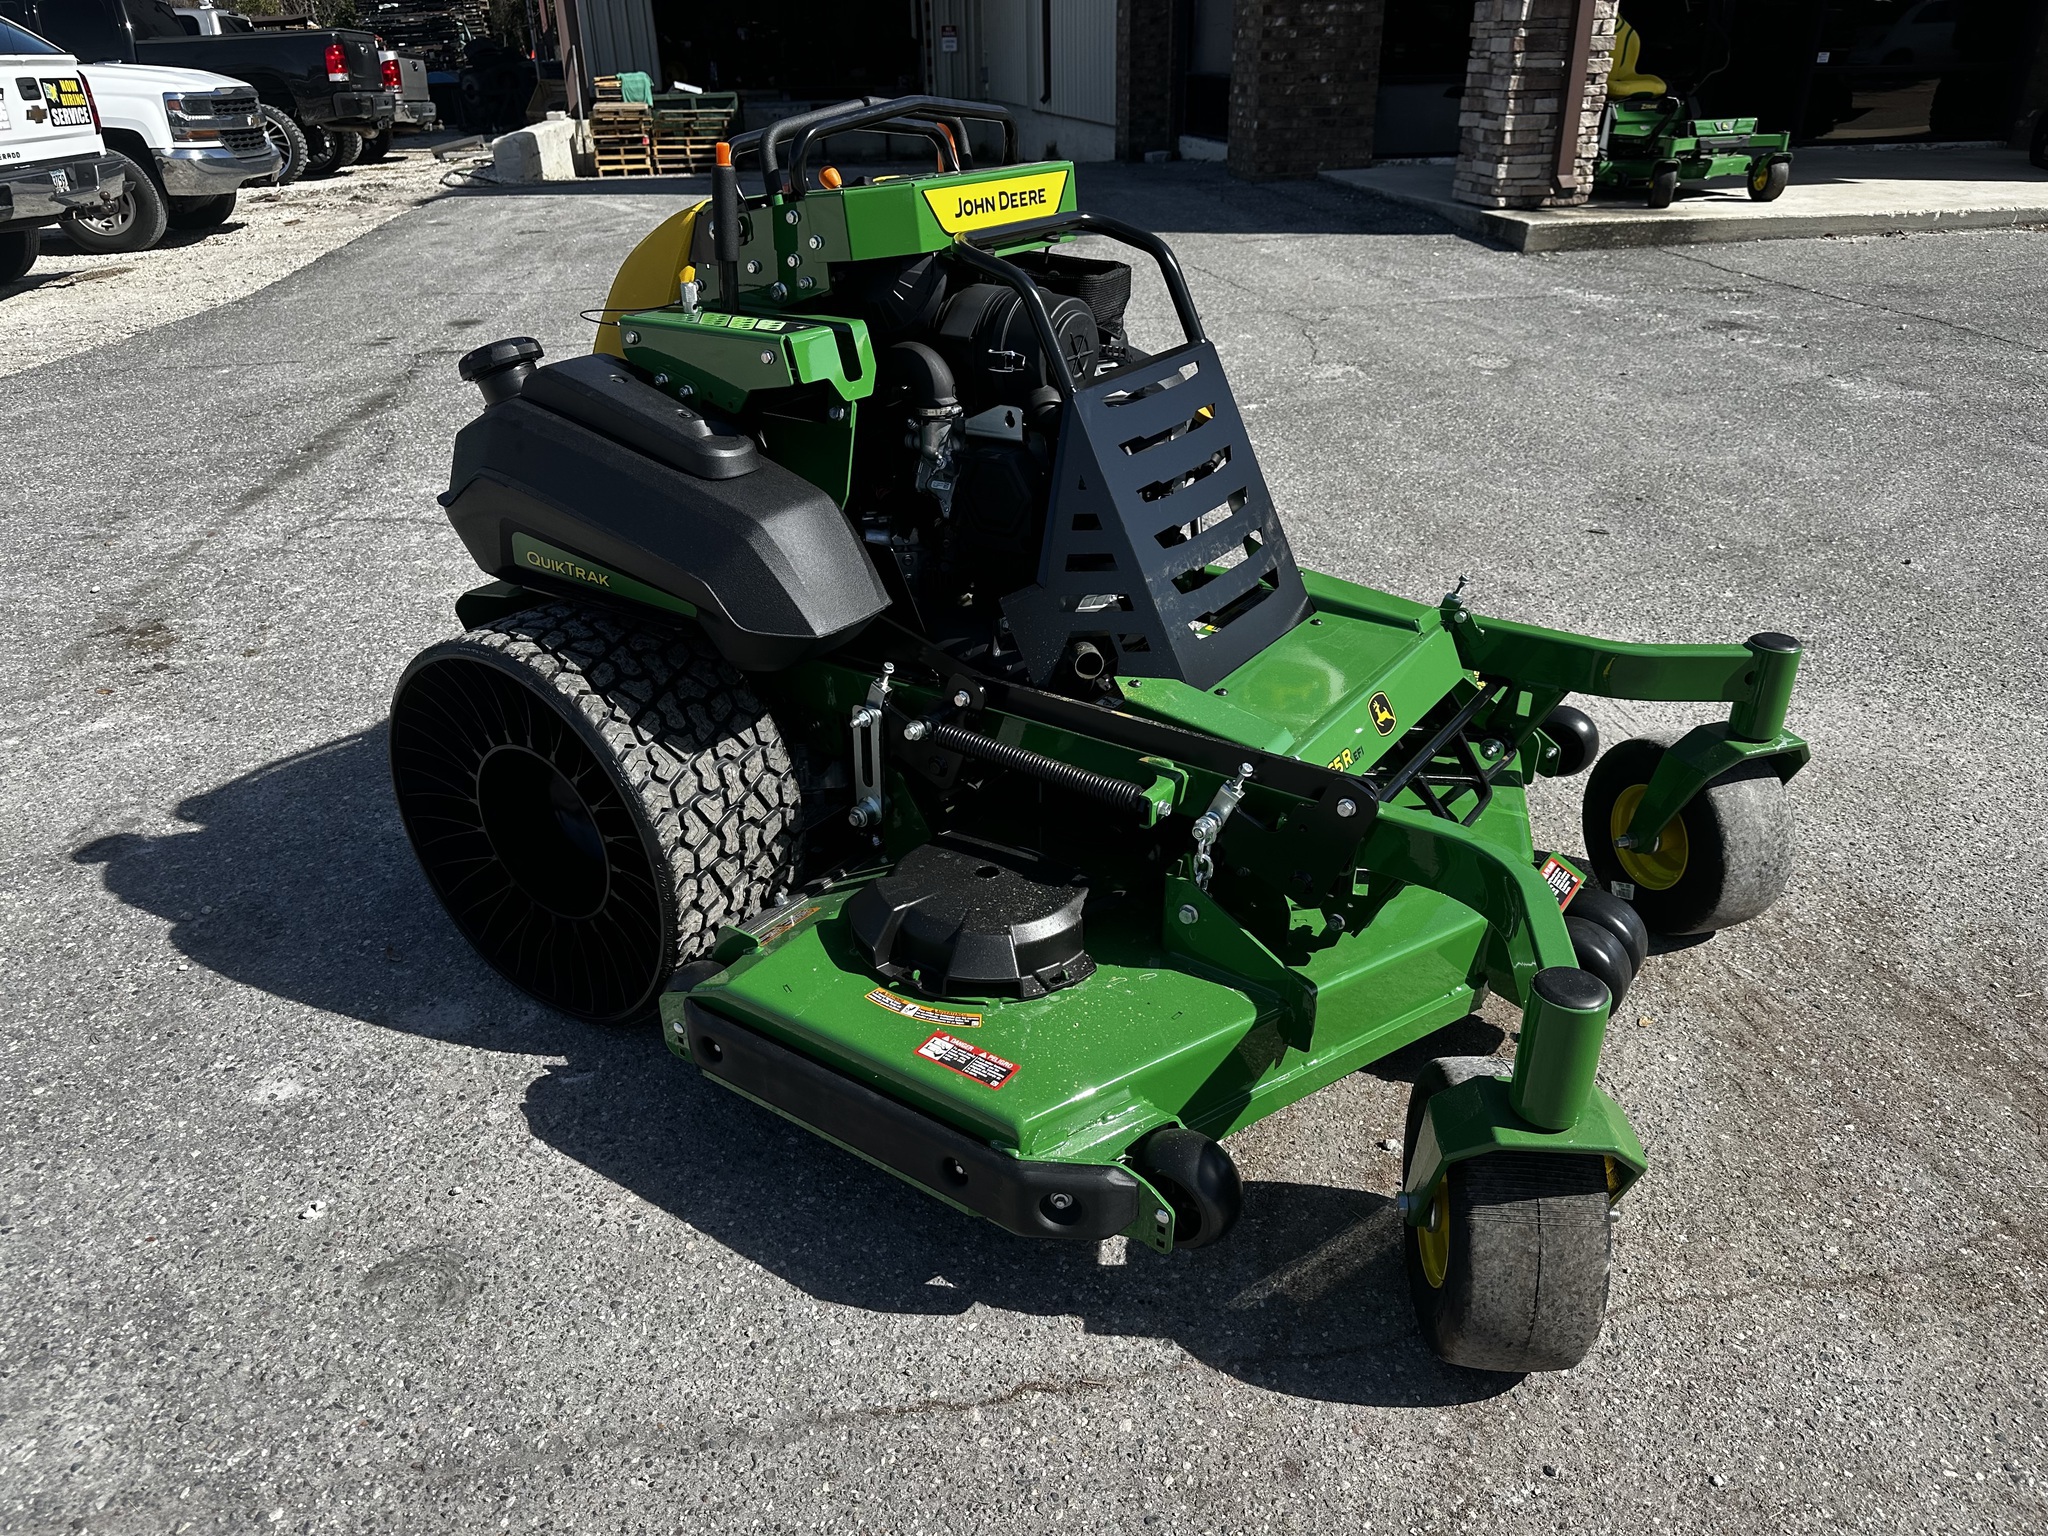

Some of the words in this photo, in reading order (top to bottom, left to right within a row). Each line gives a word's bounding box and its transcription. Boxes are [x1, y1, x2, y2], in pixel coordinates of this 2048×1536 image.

[59, 80, 78, 92] NOW
[60, 93, 86, 106] HIRING
[51, 108, 90, 125] SERVICE
[955, 196, 995, 218] JOHN
[998, 188, 1046, 210] DEERE
[526, 551, 610, 587] QUIKTRAK
[950, 1038, 975, 1052] DANGER
[987, 1055, 1013, 1069] PELIGRO
